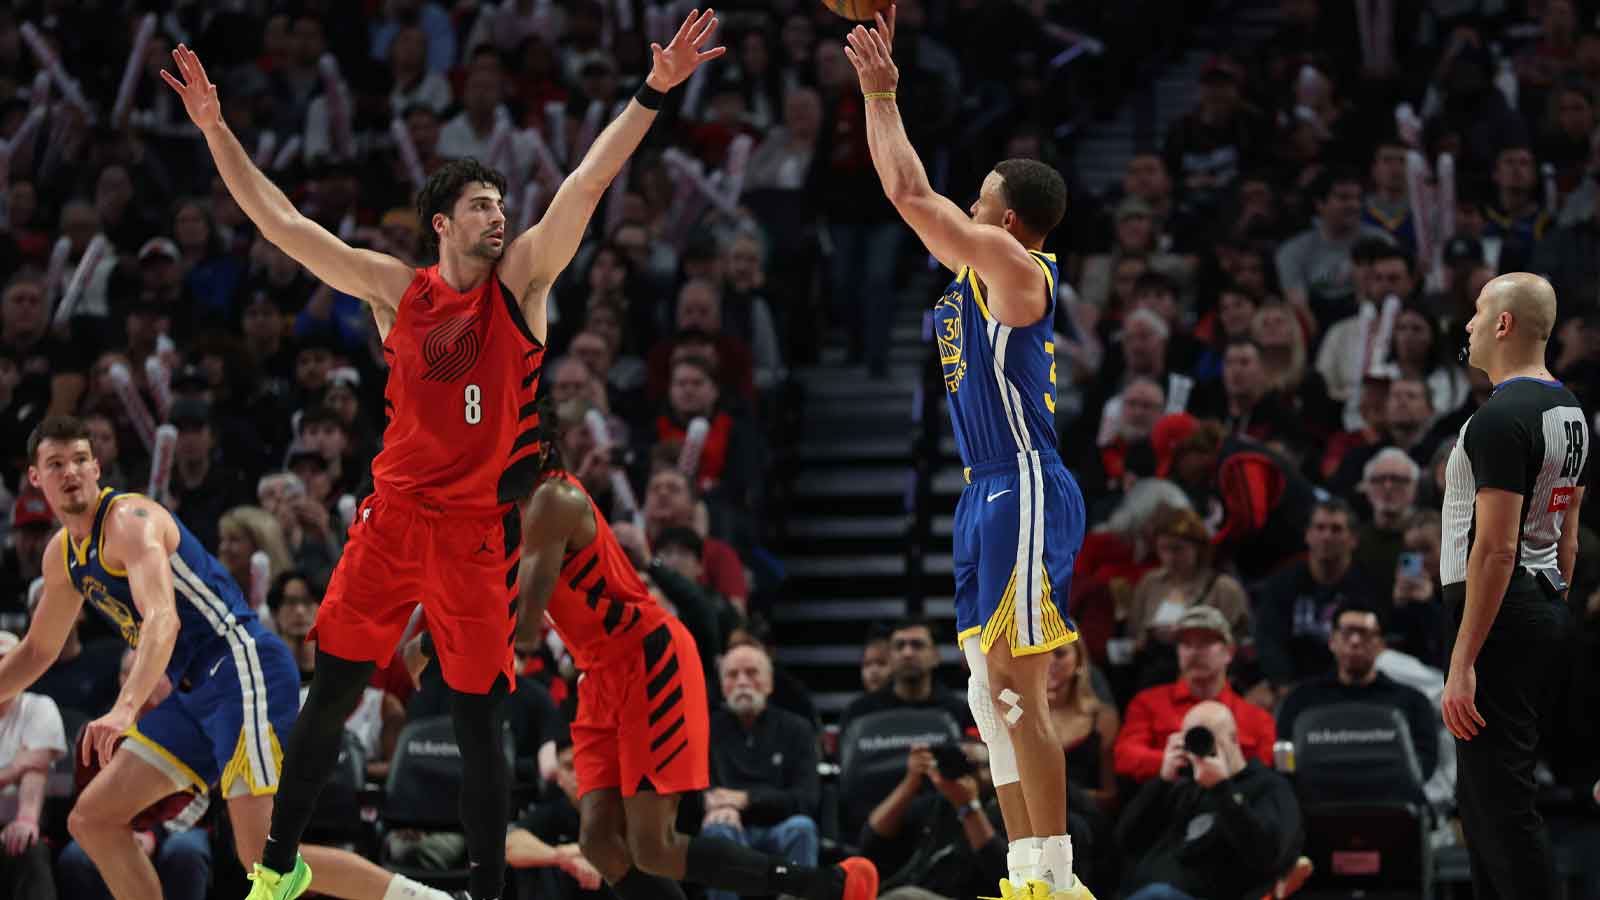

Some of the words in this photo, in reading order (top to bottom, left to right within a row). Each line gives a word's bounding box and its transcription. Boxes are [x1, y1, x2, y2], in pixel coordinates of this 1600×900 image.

[943, 318, 961, 342] 30
[464, 384, 481, 424] 8
[1560, 420, 1583, 478] 28
